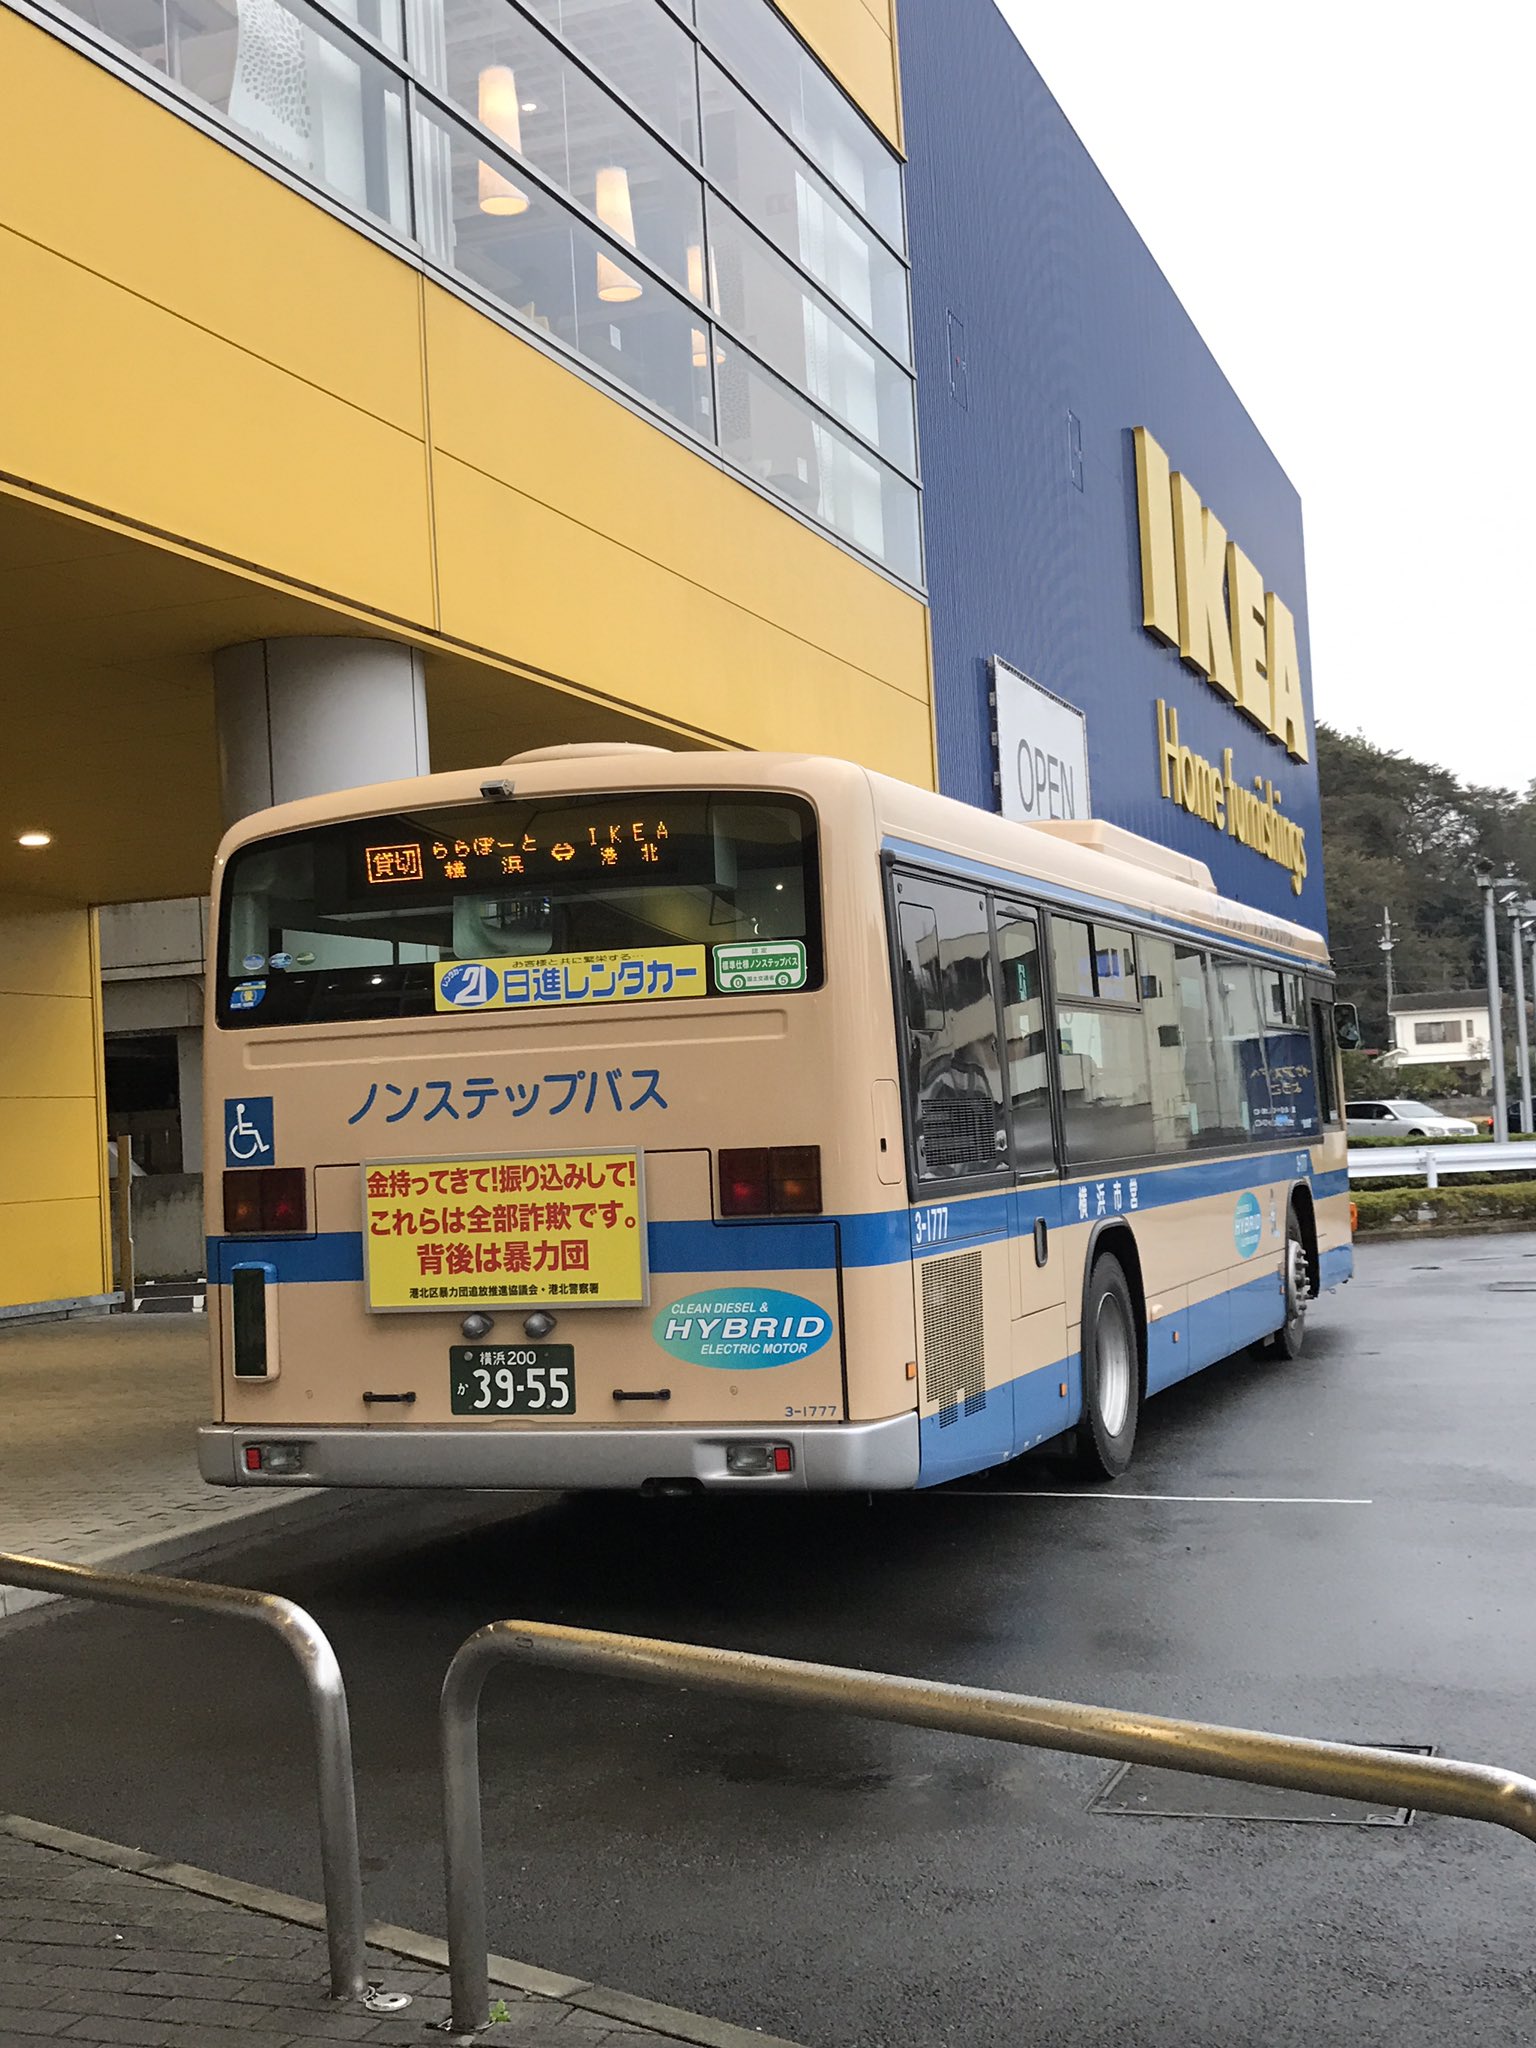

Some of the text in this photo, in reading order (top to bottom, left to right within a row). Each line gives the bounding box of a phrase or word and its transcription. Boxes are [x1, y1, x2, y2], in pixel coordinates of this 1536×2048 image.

[1133, 426, 1309, 764] IKEA
[1017, 738, 1075, 820] OPEN
[1157, 699, 1307, 895] Home furnishings
[372, 850, 417, 877] 貸切
[432, 833, 537, 860] ららぽーと
[503, 959, 697, 1004] 日進レンタカー
[348, 1068, 668, 1125] ノンステップバス
[370, 1200, 637, 1236] これらは全部詐欺です。
[915, 1206, 949, 1245] 3-1777
[417, 1239, 590, 1276] 背後は暴力団
[671, 1302, 769, 1314] CLEAN DIESEL &
[664, 1316, 826, 1340] HYBRID
[701, 1343, 808, 1355] ELECTRIC MOTOR
[457, 1367, 569, 1408] か 39-55
[784, 1405, 837, 1417] 3-1777
